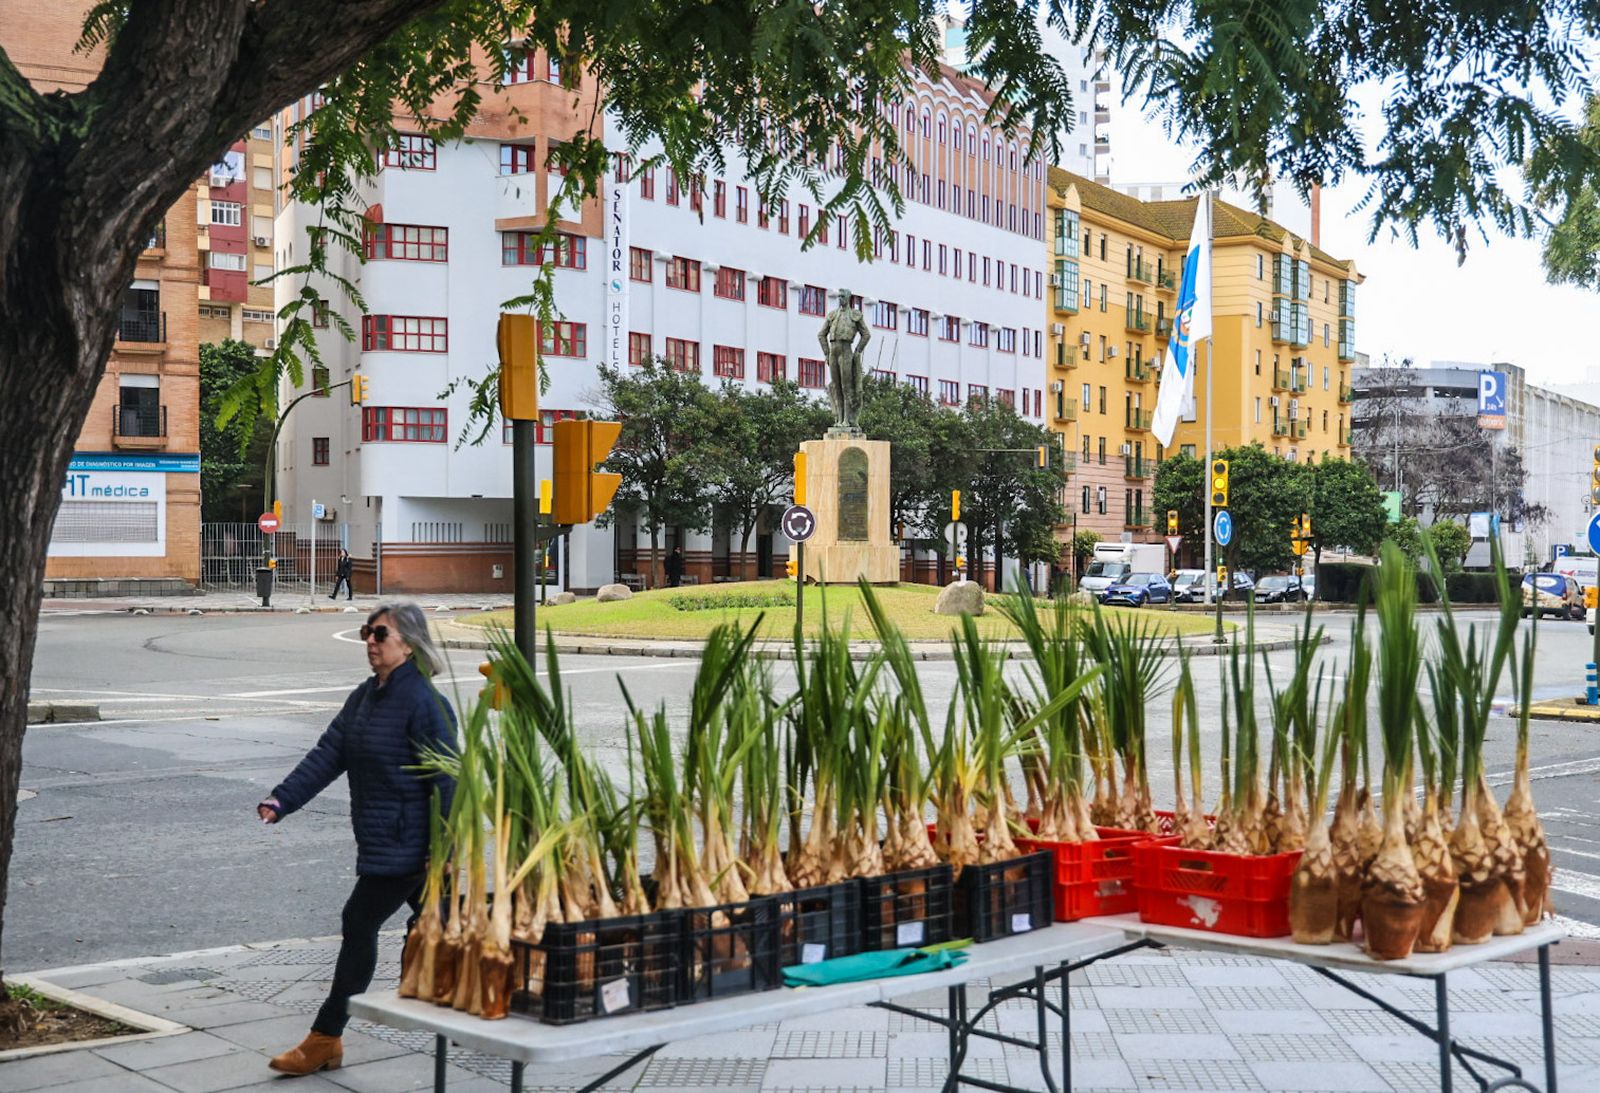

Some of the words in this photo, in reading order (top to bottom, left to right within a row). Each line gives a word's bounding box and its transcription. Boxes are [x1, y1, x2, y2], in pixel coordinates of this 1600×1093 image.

[612, 189, 622, 271] SENATOR
[612, 302, 621, 373] HOTELS
[1480, 374, 1497, 410] P
[91, 484, 149, 497] médica
[1556, 546, 1566, 557] P
